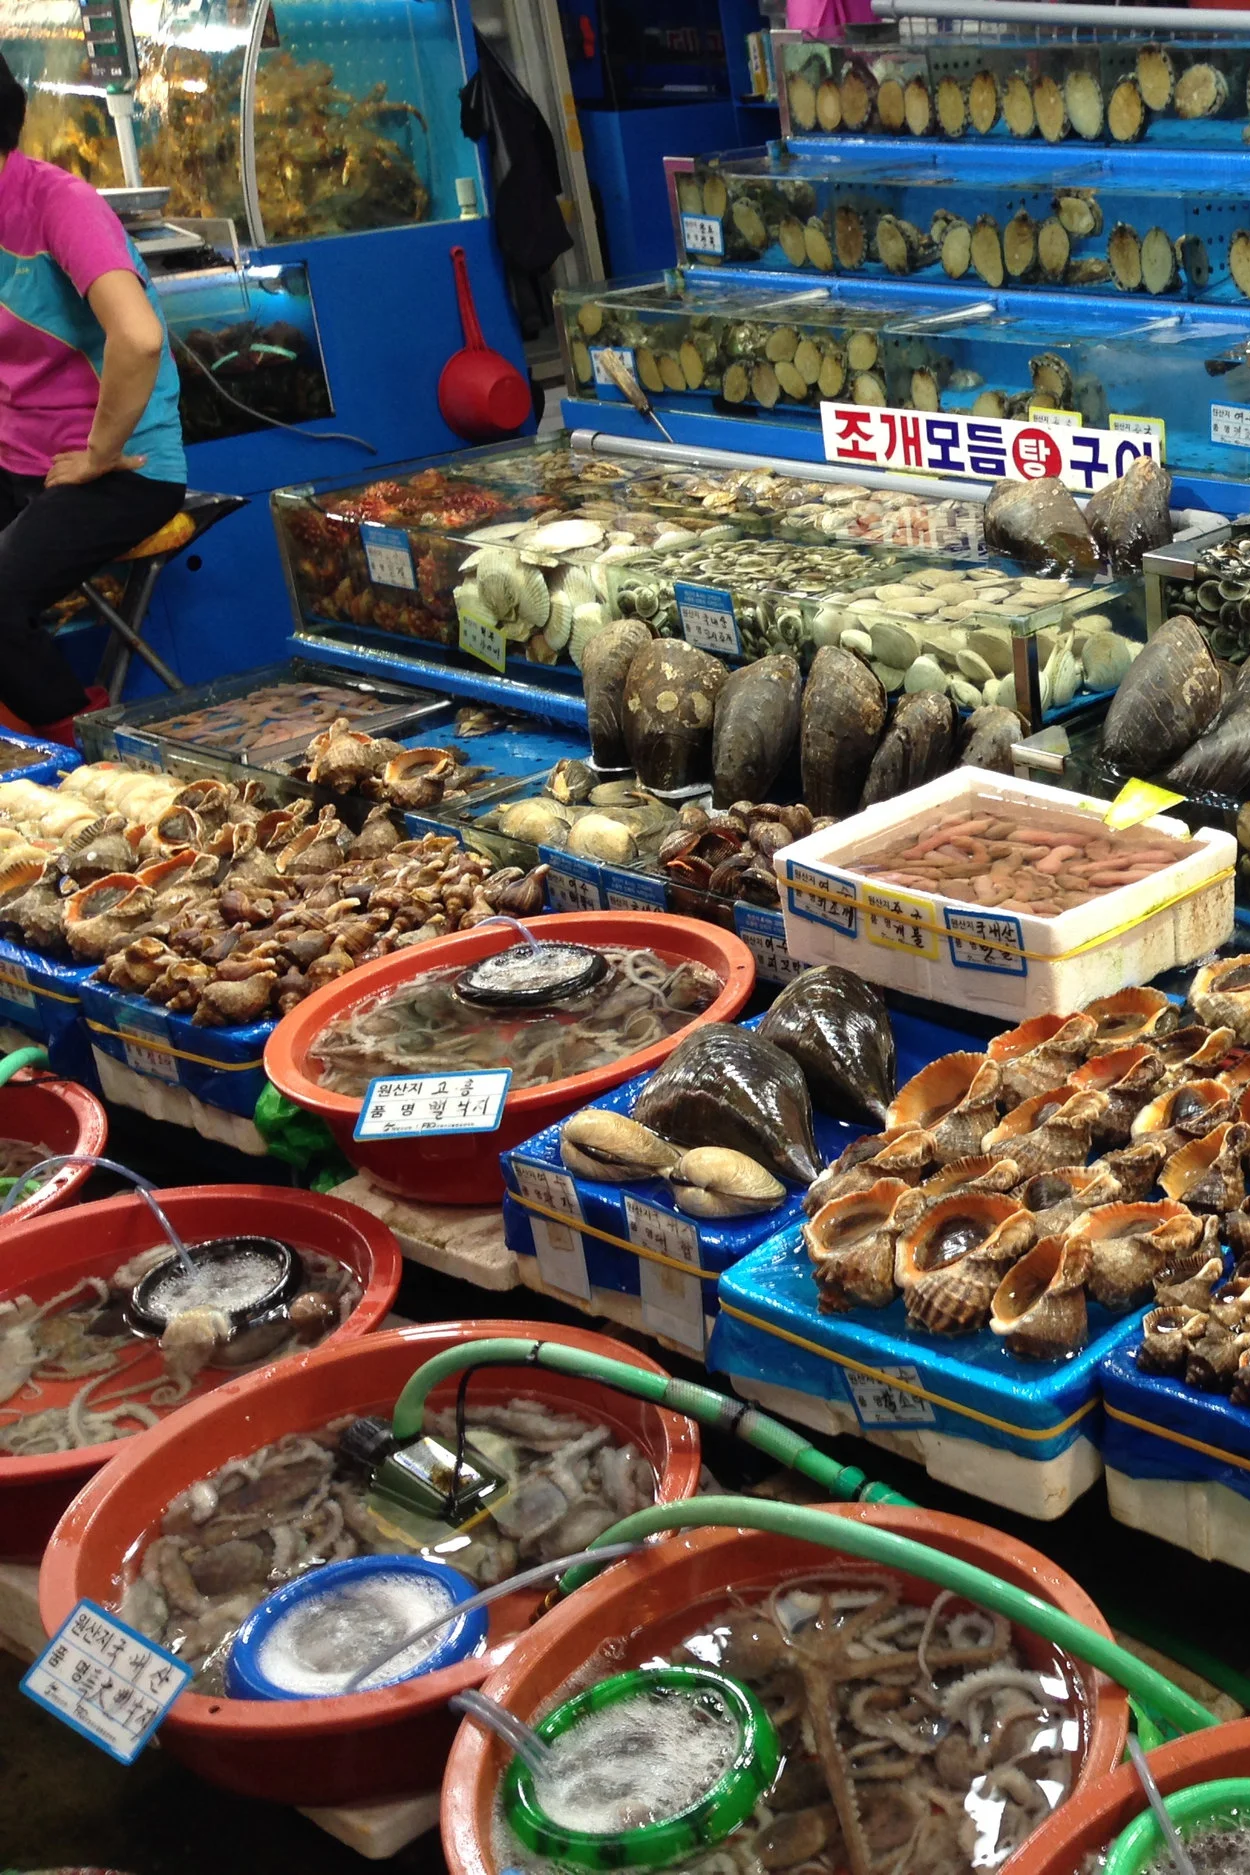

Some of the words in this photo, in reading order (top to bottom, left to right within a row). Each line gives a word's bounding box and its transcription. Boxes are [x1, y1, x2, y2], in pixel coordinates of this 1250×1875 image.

[951, 918, 975, 931] 원산지
[976, 919, 1016, 942] 국내산
[377, 1081, 423, 1098] 원산지
[70, 1613, 110, 1654] 원산지
